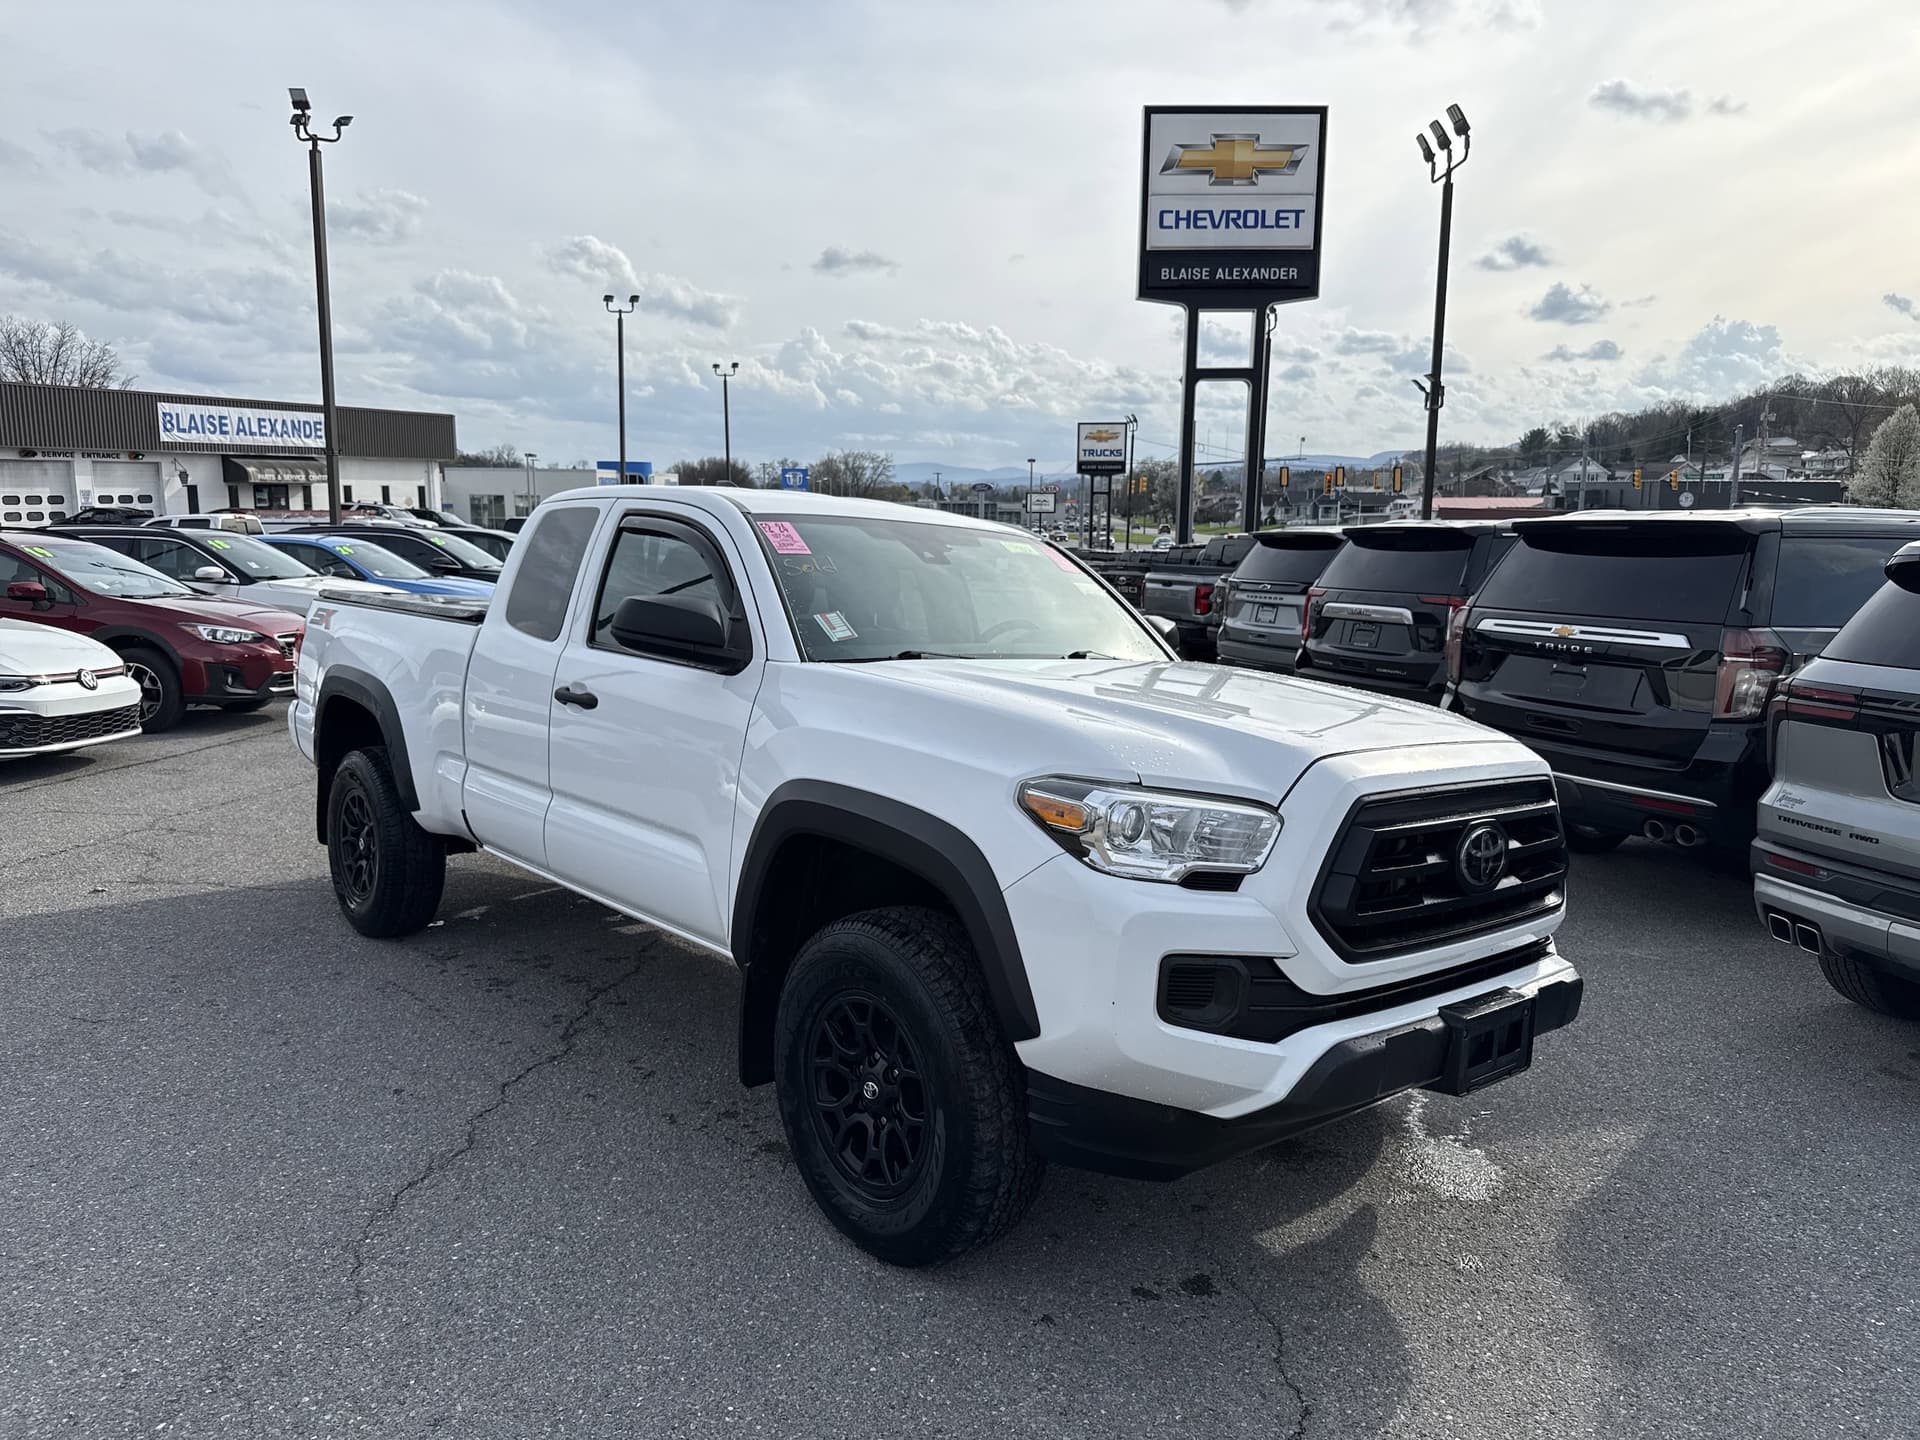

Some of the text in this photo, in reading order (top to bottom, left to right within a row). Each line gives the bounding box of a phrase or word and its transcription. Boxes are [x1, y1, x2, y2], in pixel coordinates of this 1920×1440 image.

[1159, 209, 1305, 229] CHEVROLET
[1160, 267, 1298, 280] BLAISE ALEXANDER
[161, 411, 324, 439] BLAISE ALEXANDE
[41, 450, 76, 458] SERVICE
[1082, 448, 1123, 457] TRUCKS
[1534, 641, 1593, 654] TAHOE
[1776, 815, 1880, 845] TRAVERSE AWD
